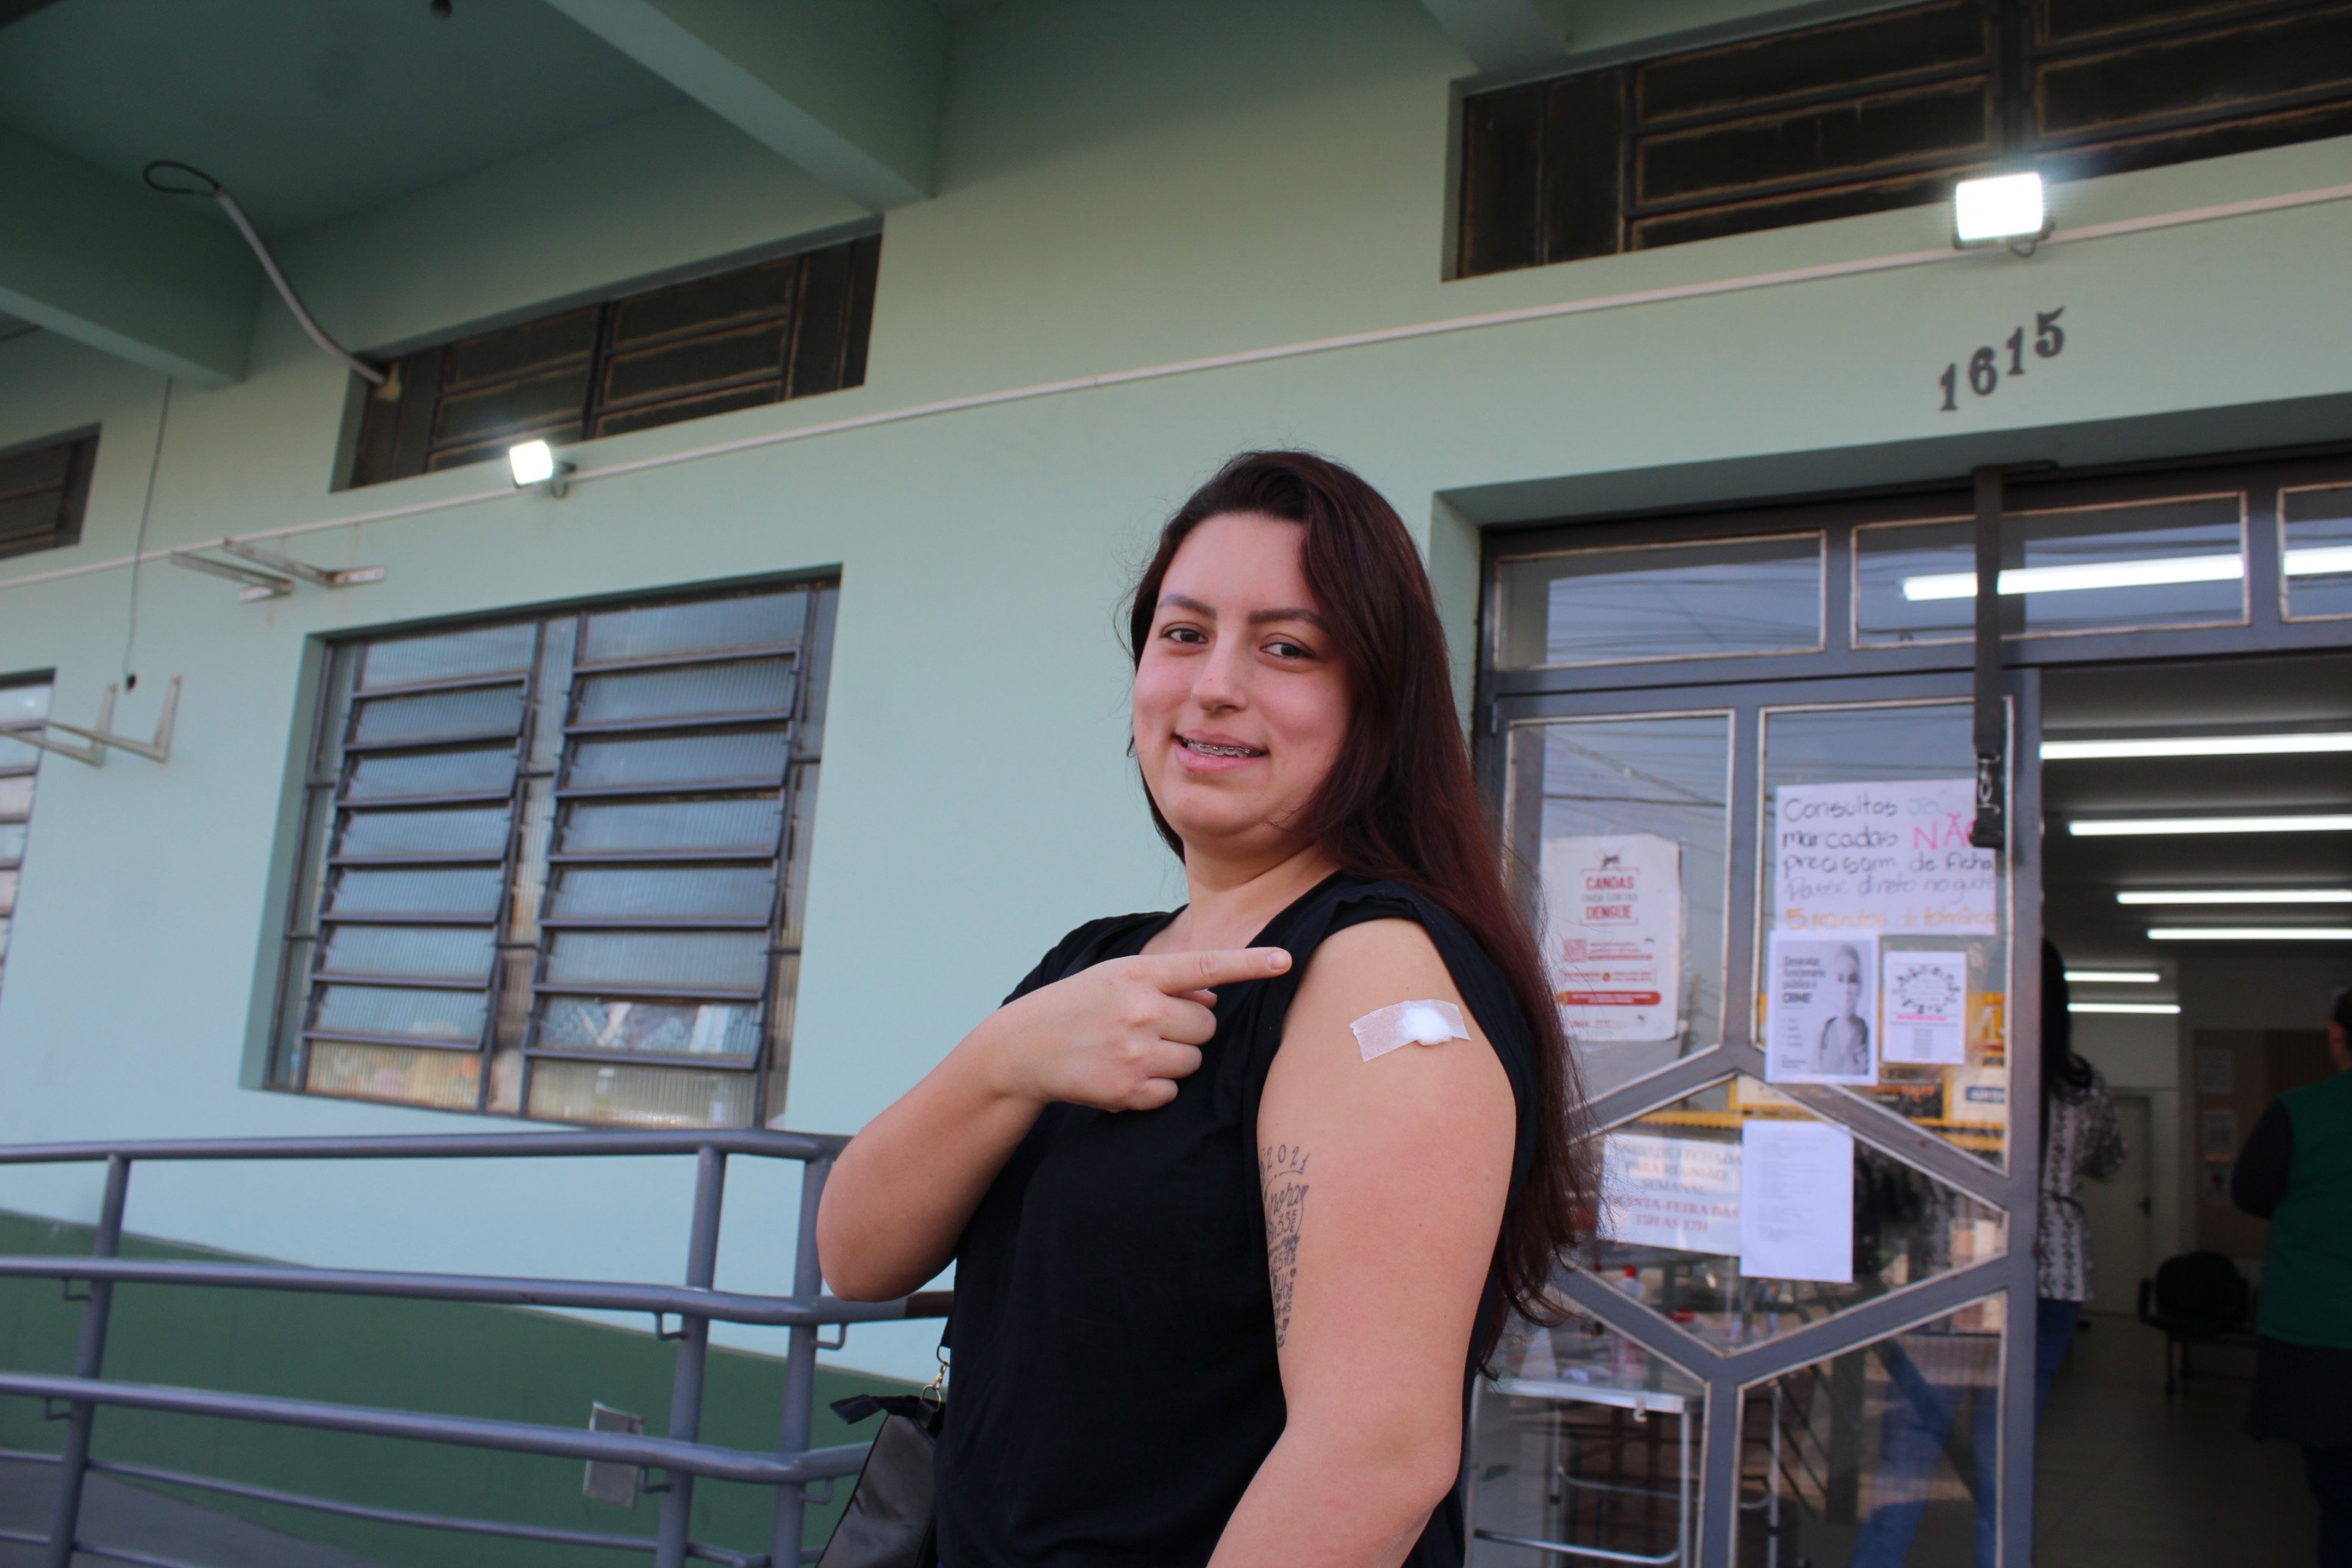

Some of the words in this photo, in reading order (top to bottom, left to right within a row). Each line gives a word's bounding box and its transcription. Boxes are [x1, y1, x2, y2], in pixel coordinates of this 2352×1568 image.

[1939, 305, 2065, 412] 1615
[1913, 812, 1976, 849] NÃ
[1586, 875, 1635, 890] CANOAS
[1586, 905, 1633, 920] DENGUE
[1784, 908, 1807, 932] 5
